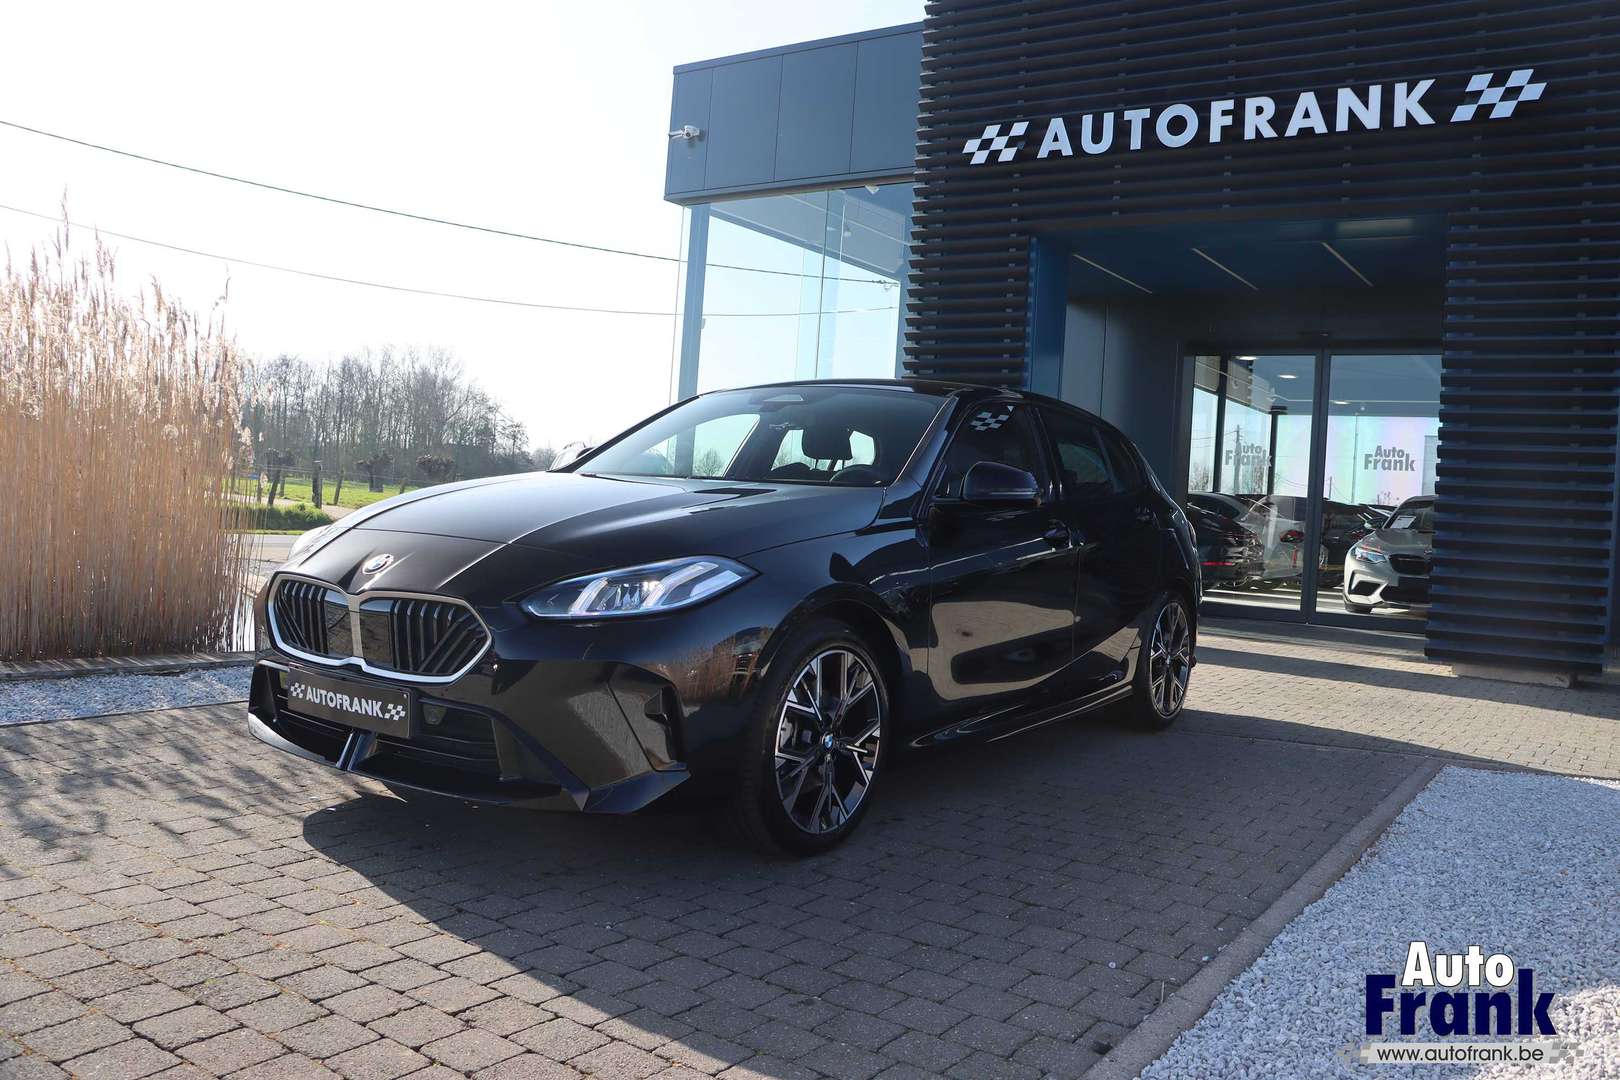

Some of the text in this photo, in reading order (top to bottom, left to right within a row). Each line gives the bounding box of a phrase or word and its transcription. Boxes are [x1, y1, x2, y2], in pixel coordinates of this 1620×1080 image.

[1036, 79, 1437, 159] AUTOFRANK
[1364, 453, 1416, 471] Frank
[1374, 445, 1405, 458] Auto
[306, 686, 384, 718] AUTOFRANK
